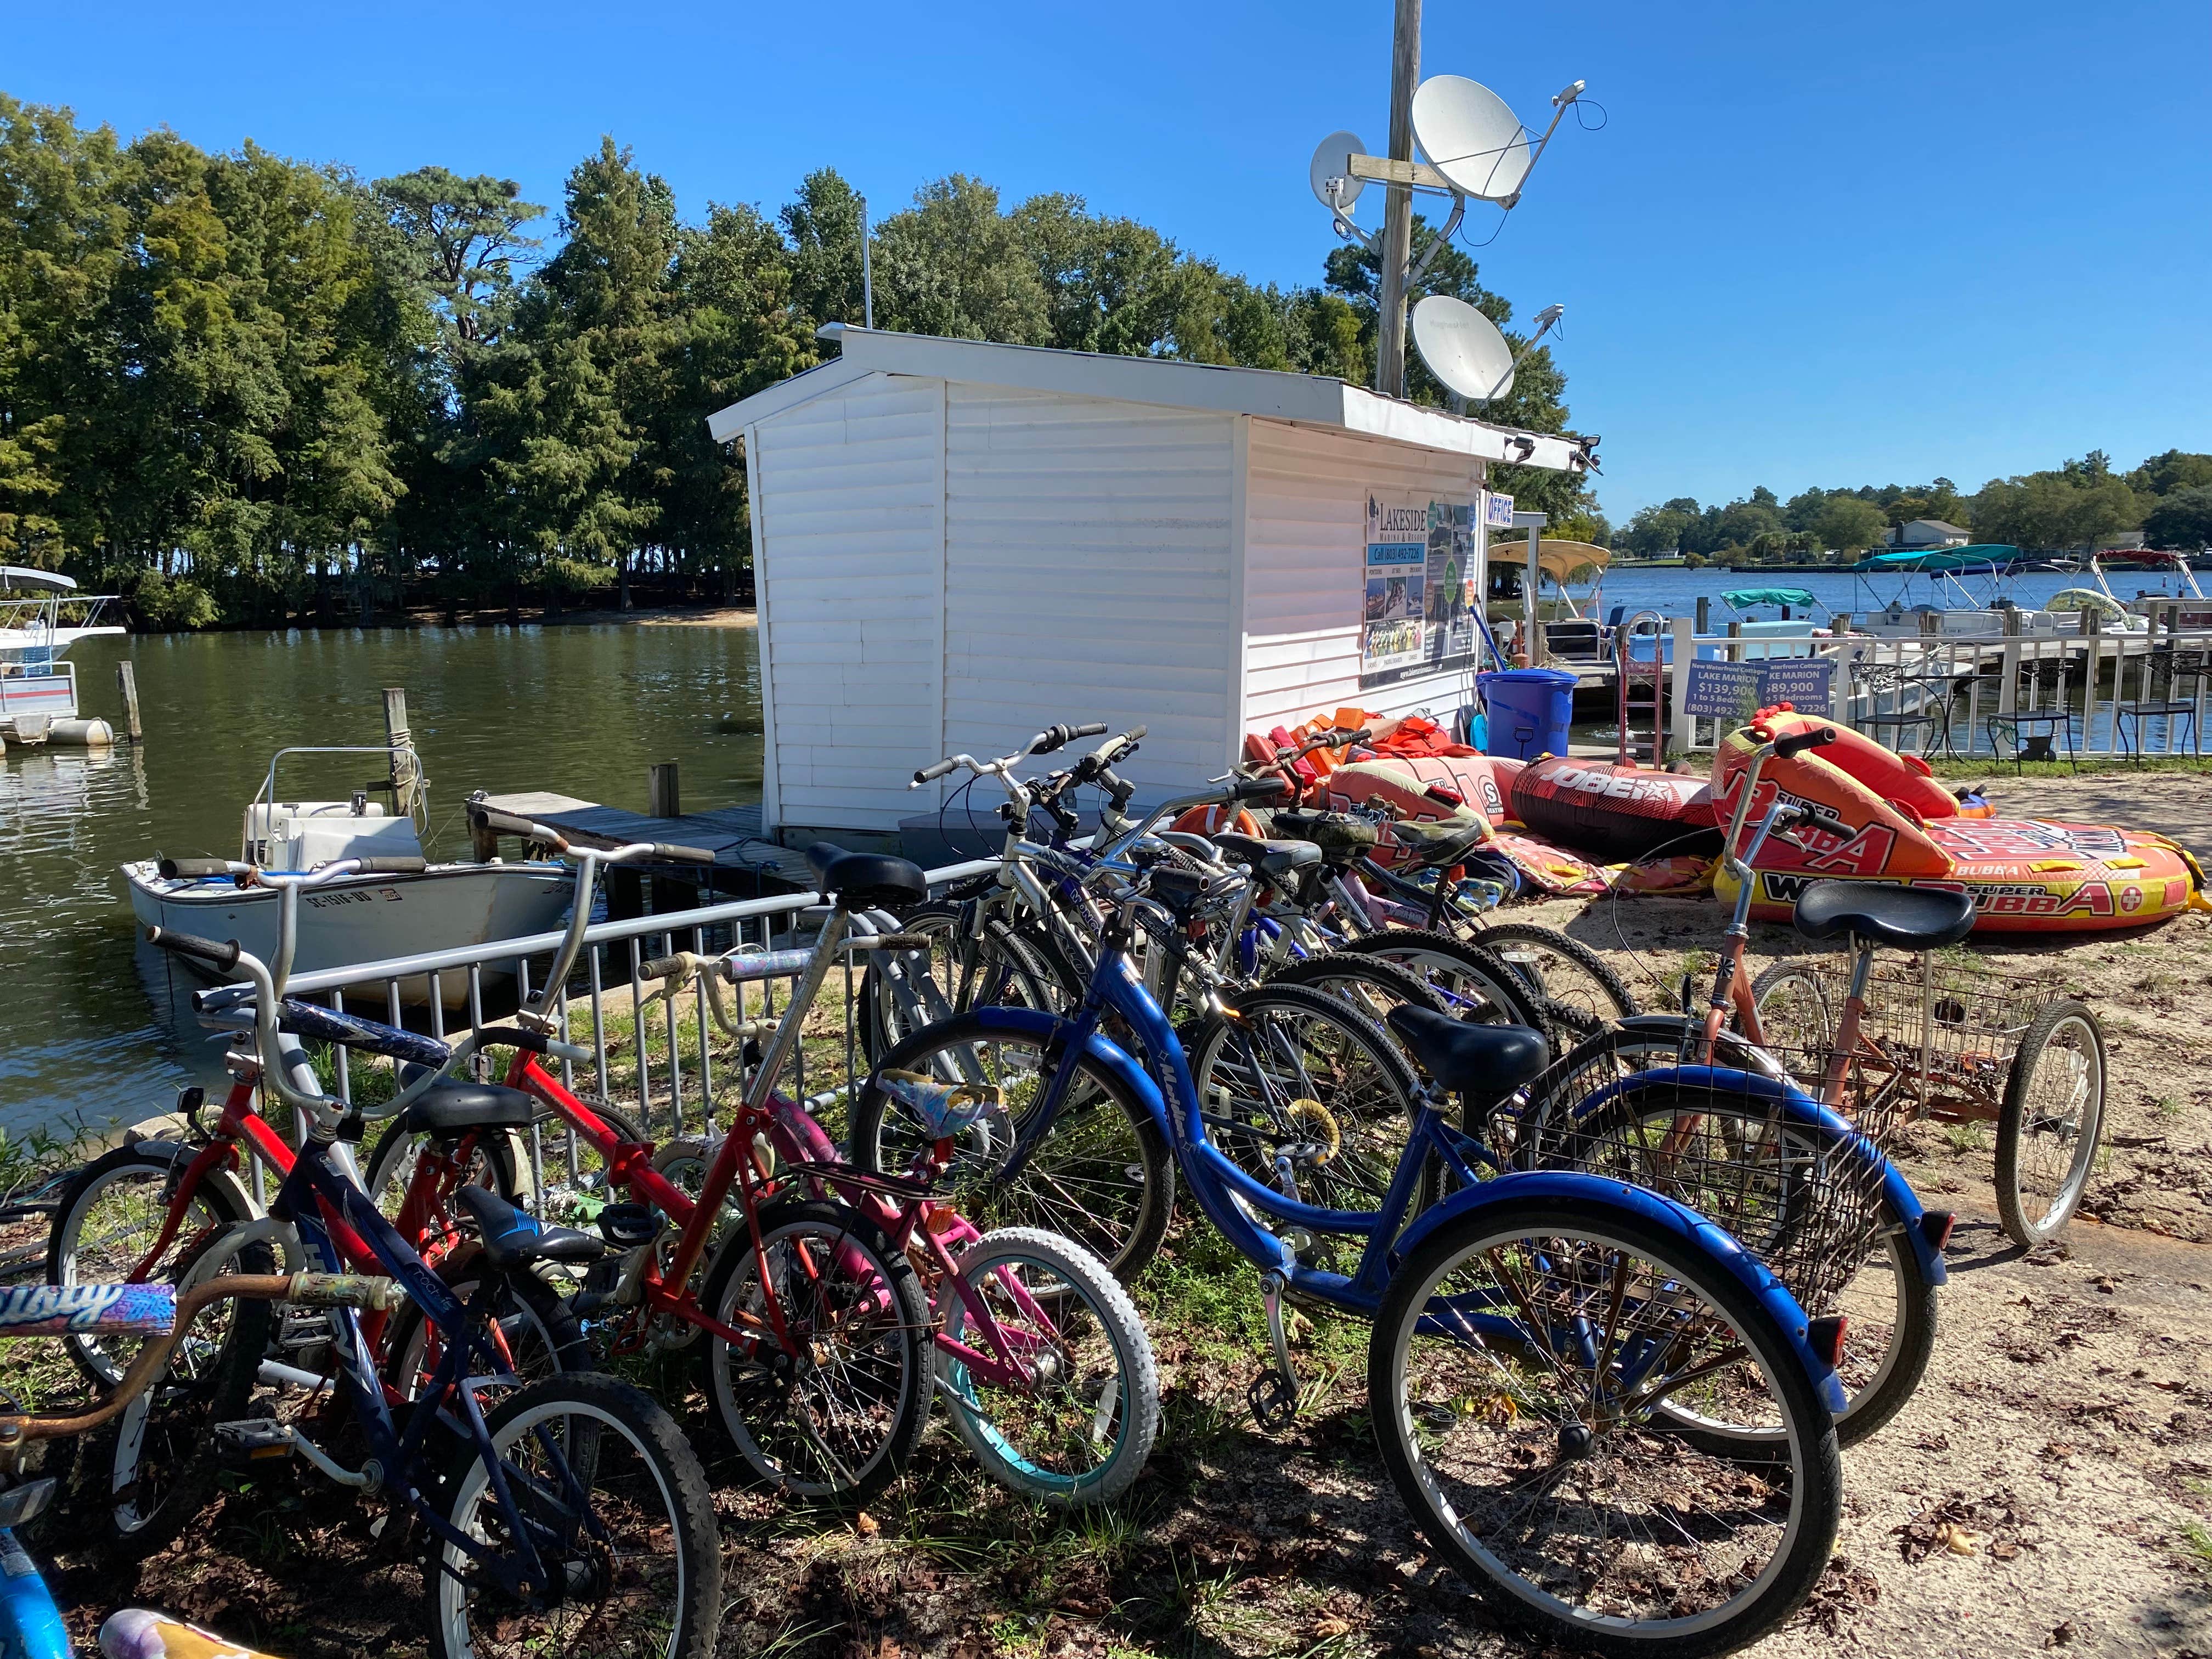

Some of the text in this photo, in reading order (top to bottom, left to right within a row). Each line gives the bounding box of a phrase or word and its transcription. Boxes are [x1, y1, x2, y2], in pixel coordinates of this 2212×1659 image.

[1488, 495, 1513, 524] OFFICE
[1380, 503, 1426, 531] LAKESIDE
[1374, 547, 1419, 561] Call (803) 492-7226
[1706, 664, 1739, 673] Waterfront
[1741, 667, 1767, 675] Cottages
[1782, 671, 1820, 679] MARION
[1698, 672, 1759, 684] LAKE MARION
[1699, 681, 1756, 696] $139,900
[1688, 703, 1712, 714] (803)
[1793, 704, 1826, 713] 2-7226
[1956, 865, 2019, 876] BUBBA
[1967, 885, 2046, 896] SUPER
